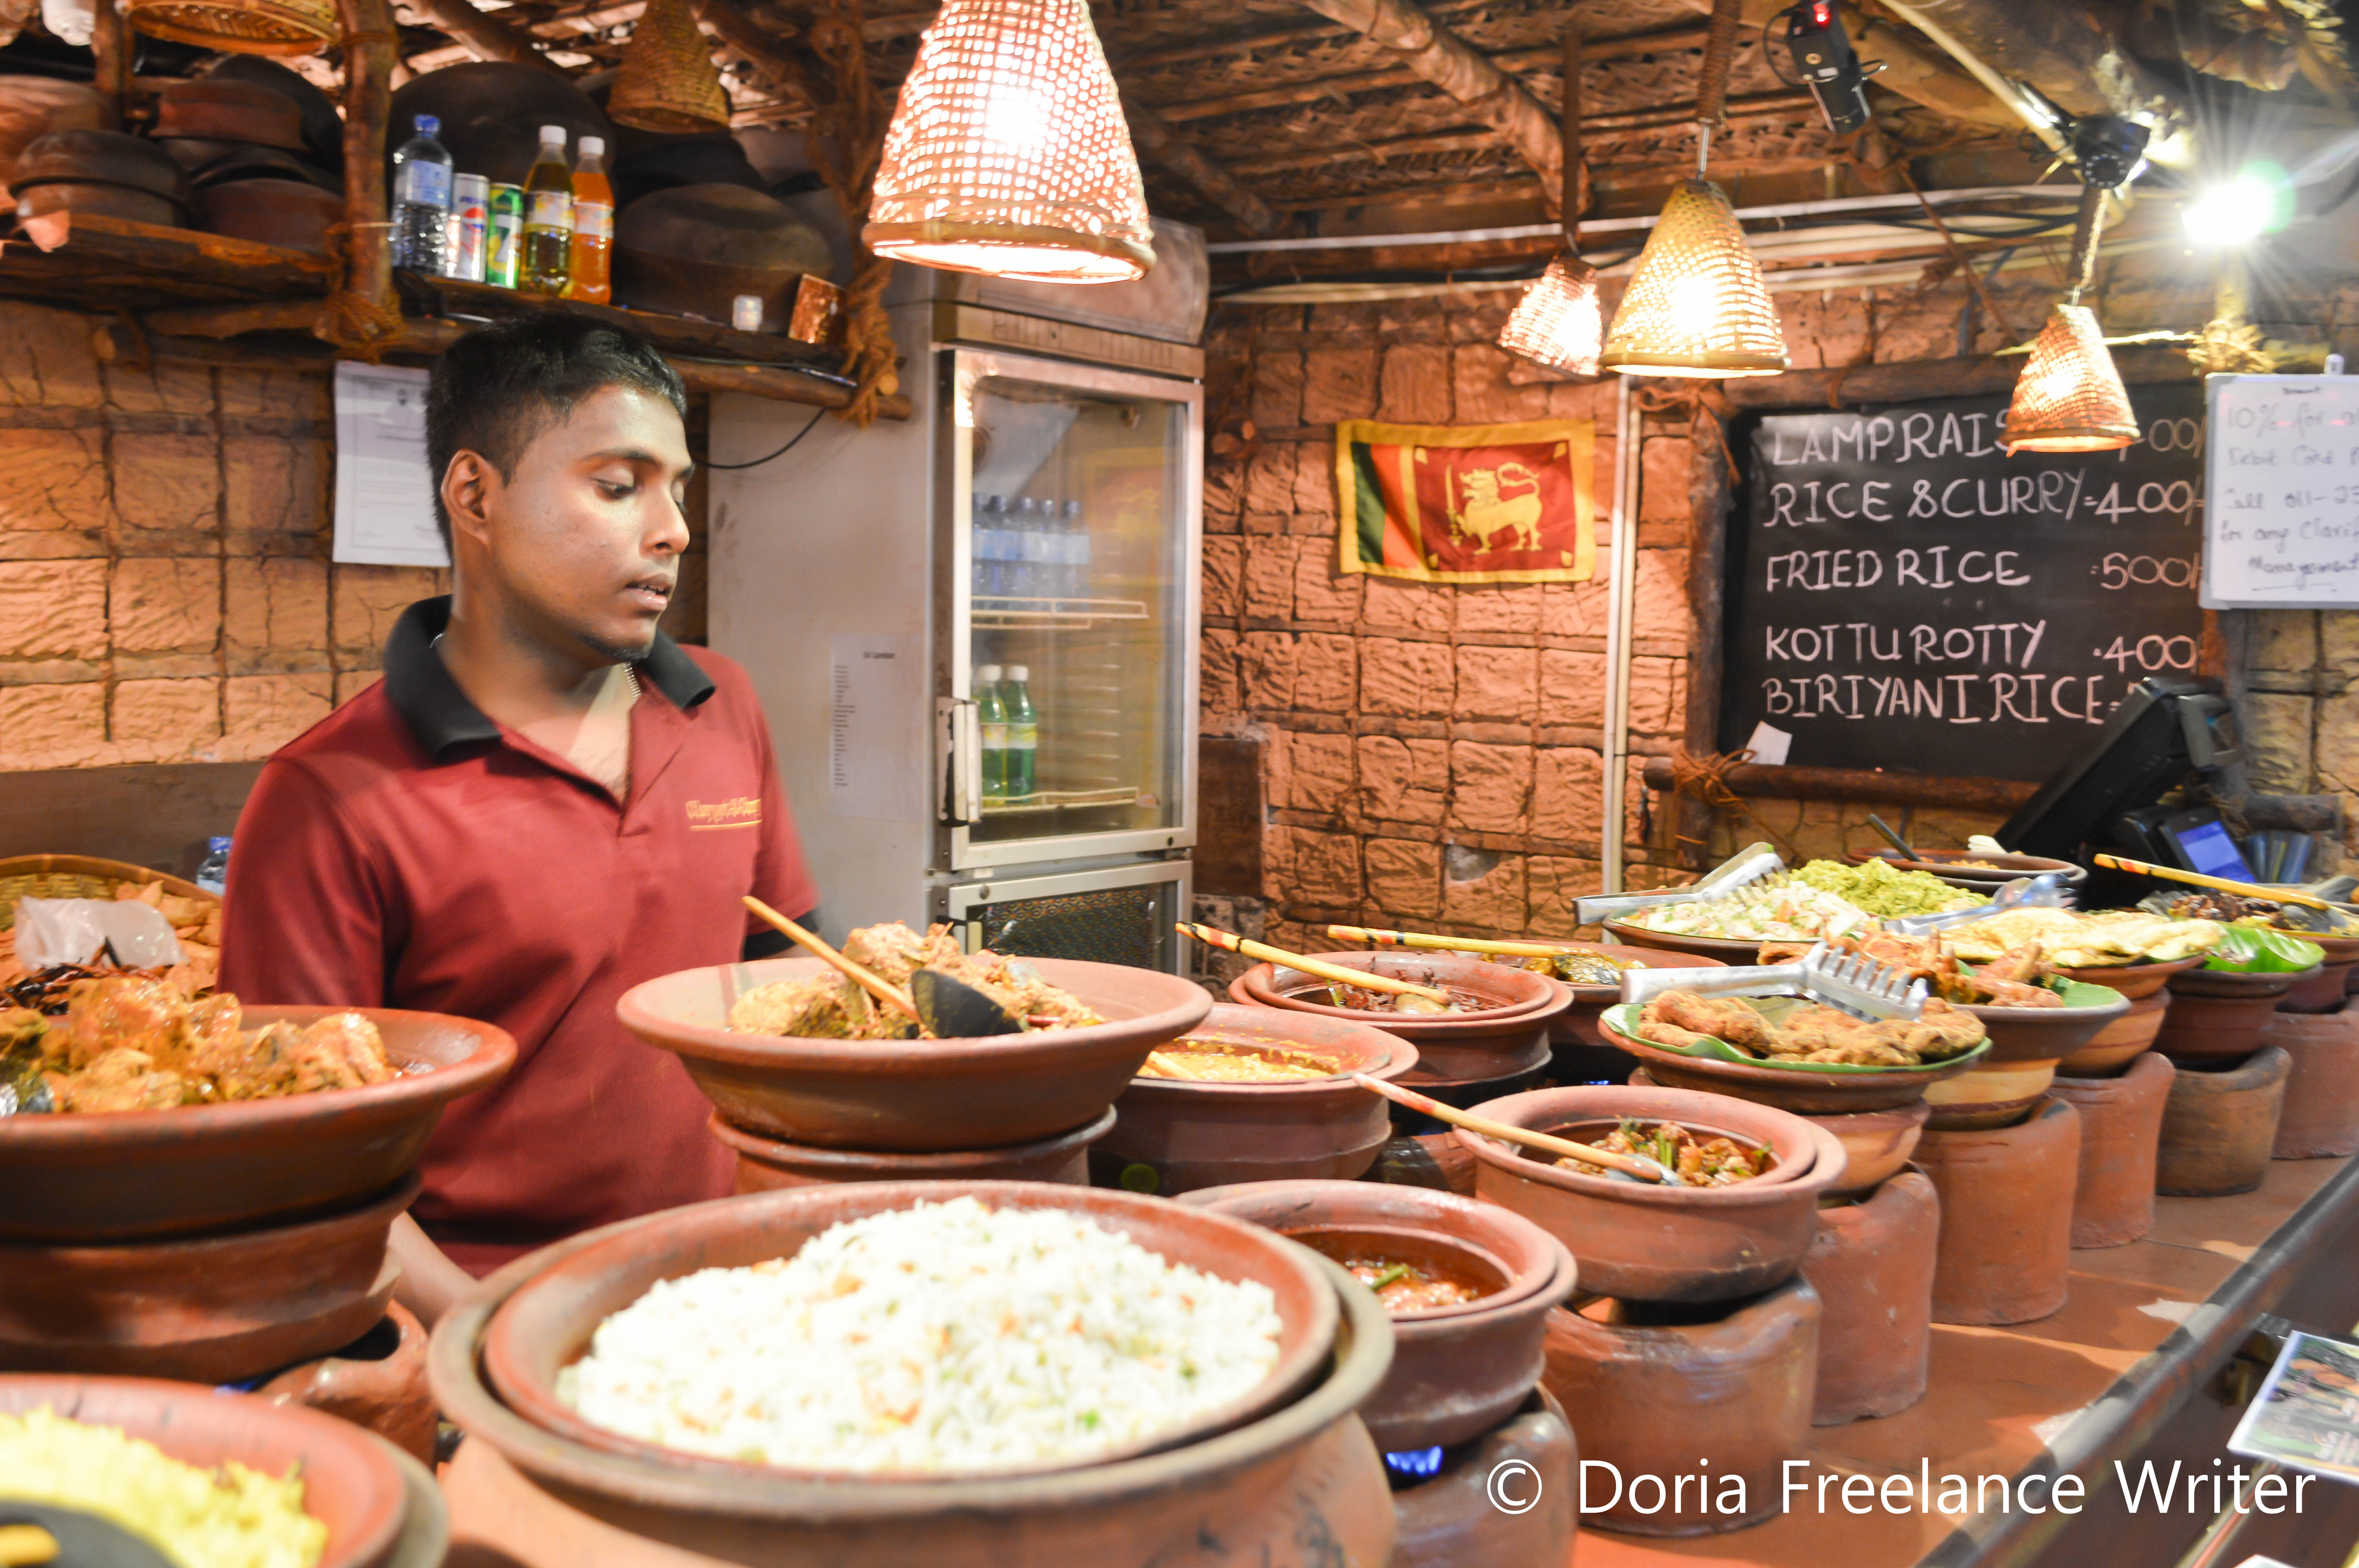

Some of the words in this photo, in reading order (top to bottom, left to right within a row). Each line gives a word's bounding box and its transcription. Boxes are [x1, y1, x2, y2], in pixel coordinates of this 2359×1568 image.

[1763, 481, 1894, 527] RICE
[1767, 550, 1883, 592] FRIED
[1896, 546, 2031, 588] RICE
[1766, 622, 1902, 664] KOTTU
[1909, 619, 2046, 668] ROTTY
[1761, 673, 1981, 724] BIRIYANI
